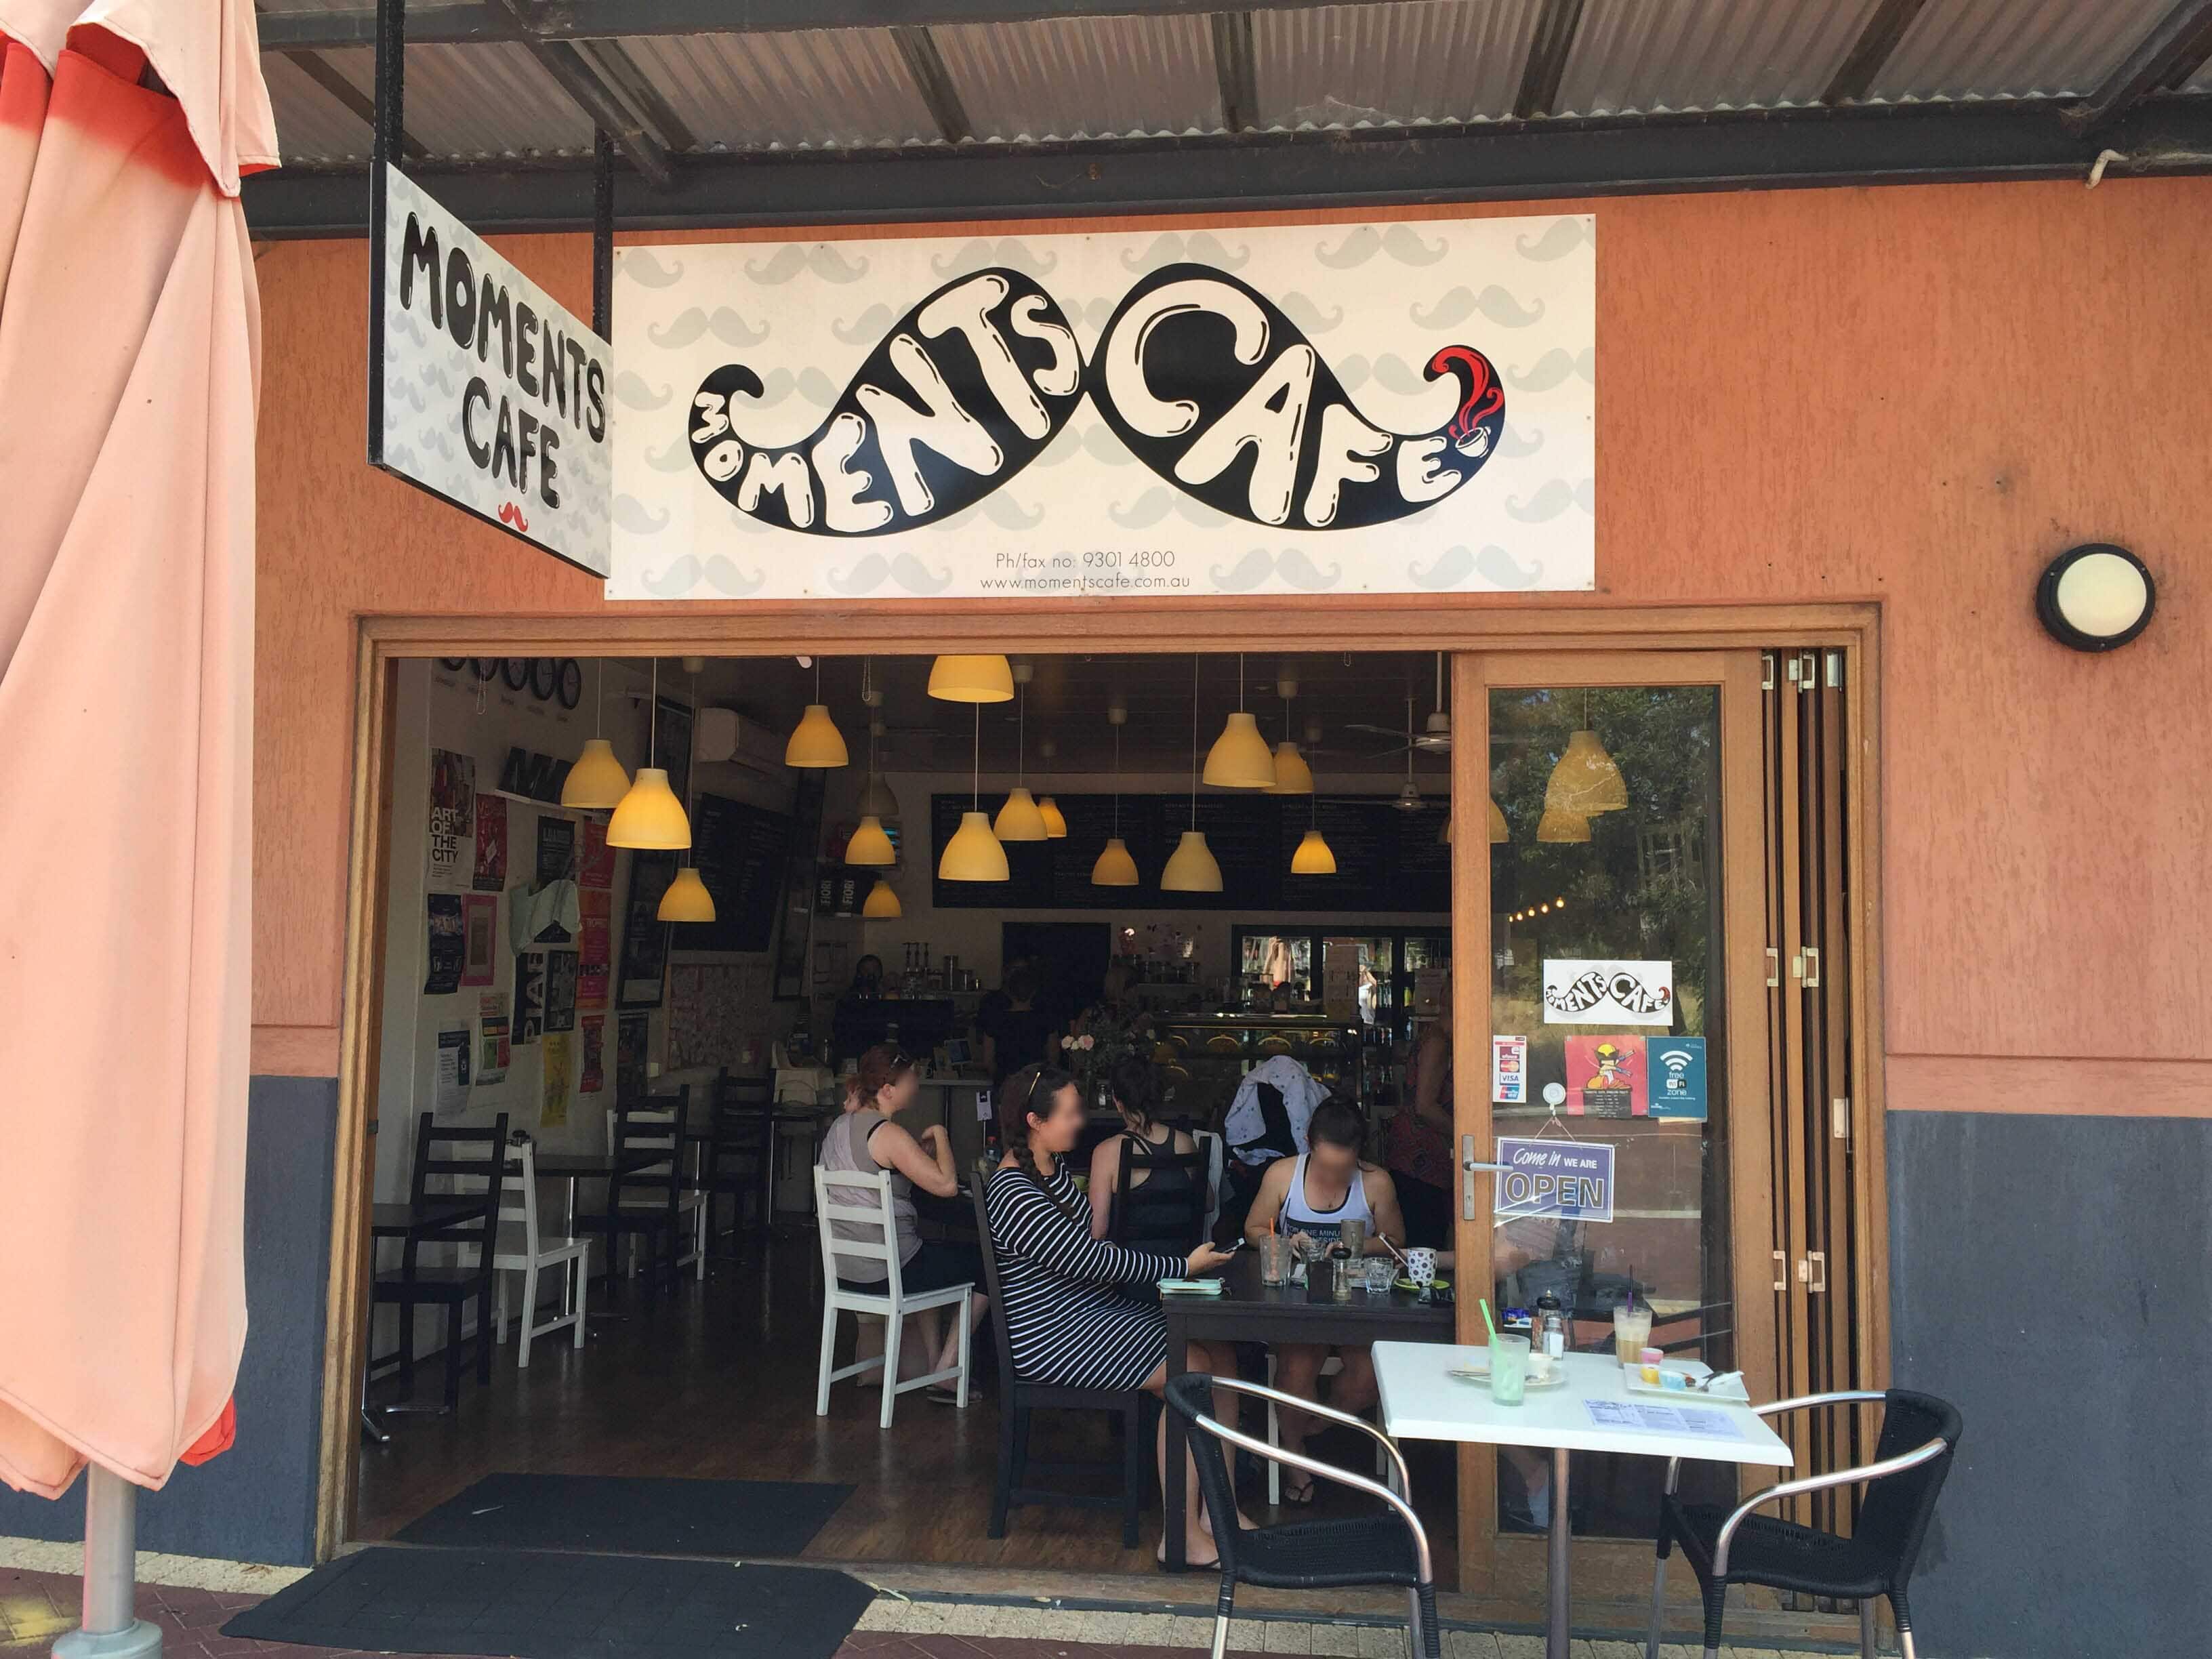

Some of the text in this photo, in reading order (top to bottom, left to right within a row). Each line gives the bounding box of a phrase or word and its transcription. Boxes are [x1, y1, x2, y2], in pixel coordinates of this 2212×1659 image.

[399, 211, 605, 443] MOMENTS
[691, 274, 1462, 533] MOMENTS CAFE
[463, 376, 560, 509] CAFE
[996, 550, 1175, 569] Ph/fax no: 9301 4800
[980, 572, 1190, 590] www.momentscafe.com.au
[432, 806, 458, 822] ART
[431, 821, 451, 834] OF
[432, 834, 457, 849] THE
[432, 848, 459, 863] CITY
[1610, 974, 1664, 1012] CAFE
[1513, 1147, 1597, 1169] Come in WE ARE
[1505, 1172, 1605, 1210] OPEN
